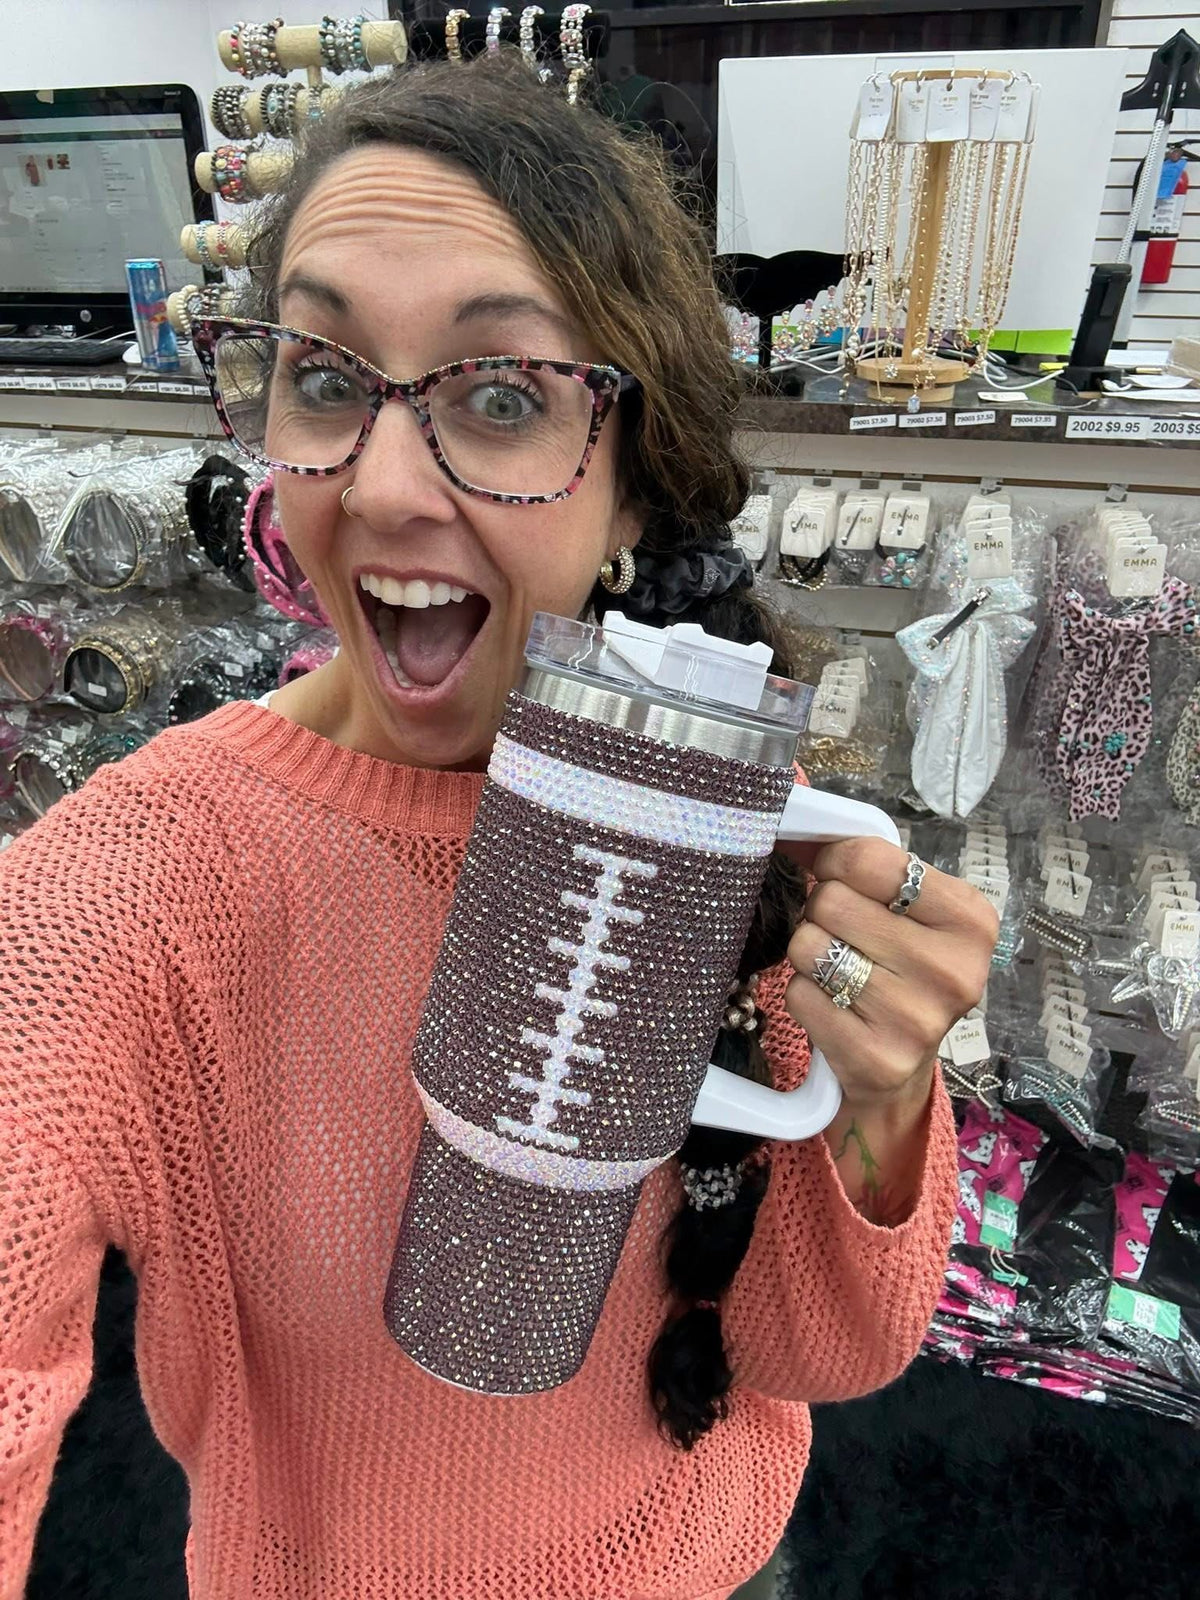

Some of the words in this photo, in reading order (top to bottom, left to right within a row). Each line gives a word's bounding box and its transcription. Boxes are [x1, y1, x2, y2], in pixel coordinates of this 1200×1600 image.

[1072, 421, 1103, 432] 2002
[1105, 421, 1140, 434] $9.95
[1152, 422, 1185, 433] 2003
[974, 540, 1004, 551] EMMA
[1123, 558, 1157, 568] EMMA
[1056, 877, 1084, 893] EMA
[1170, 922, 1195, 932] EMMA
[955, 1030, 981, 1042] EMMA
